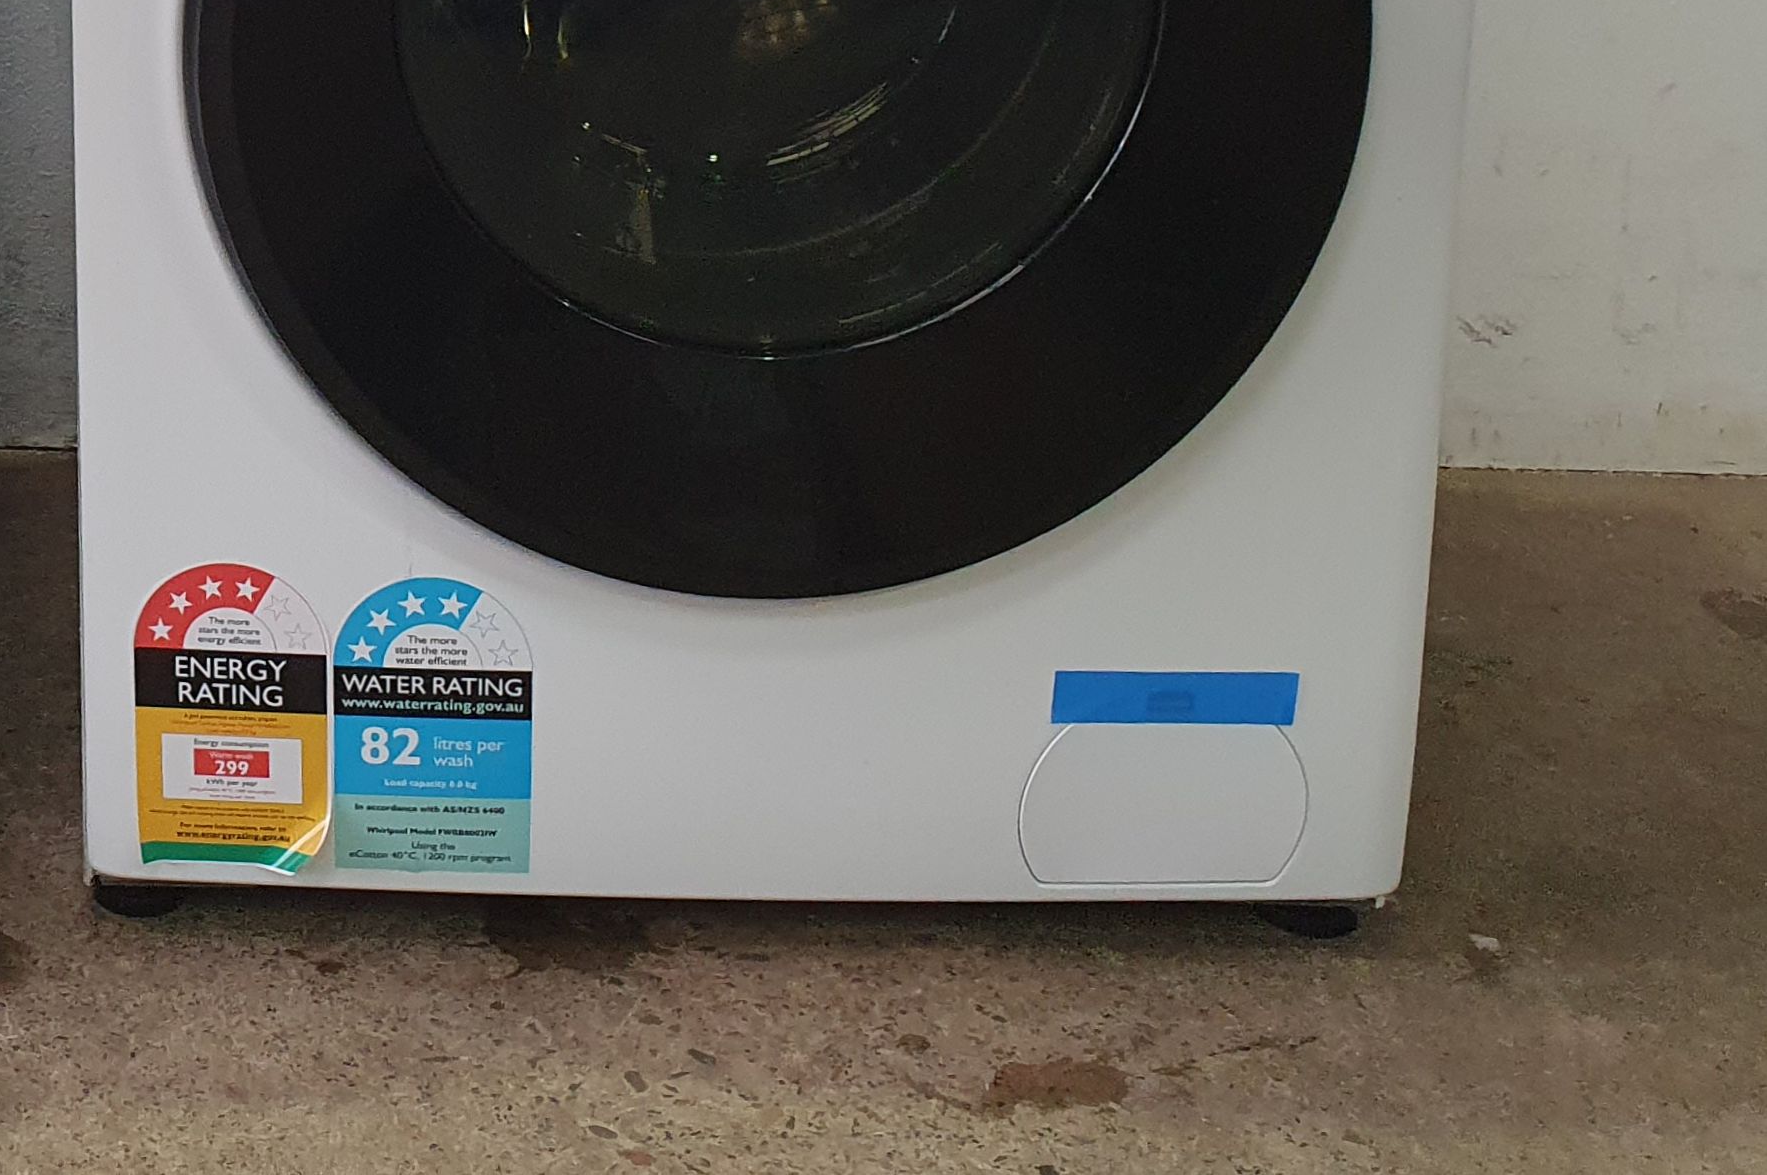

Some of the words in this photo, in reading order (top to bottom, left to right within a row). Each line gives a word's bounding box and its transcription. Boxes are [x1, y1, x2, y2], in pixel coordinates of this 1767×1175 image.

[208, 616, 224, 625] The
[227, 618, 251, 626] more
[198, 626, 219, 635] stars
[221, 627, 234, 635] the
[237, 628, 260, 636] more
[197, 637, 225, 646] energy
[407, 635, 427, 645] The
[430, 637, 458, 646] more
[394, 646, 419, 655] stars
[421, 646, 438, 656] the
[395, 657, 425, 666] water
[427, 656, 467, 666] efficient
[174, 655, 287, 682] ENERGY
[341, 673, 426, 695] WATER
[433, 676, 523, 697] RATING
[177, 682, 283, 707] RATING
[341, 697, 524, 715] www.waterrating.gov.au
[360, 726, 421, 766] 82
[433, 736, 472, 751] litres
[476, 740, 504, 755] per
[433, 754, 474, 767] wash
[214, 760, 249, 775] 299
[411, 841, 437, 851] Using
[439, 842, 456, 850] the
[470, 854, 511, 863] program
